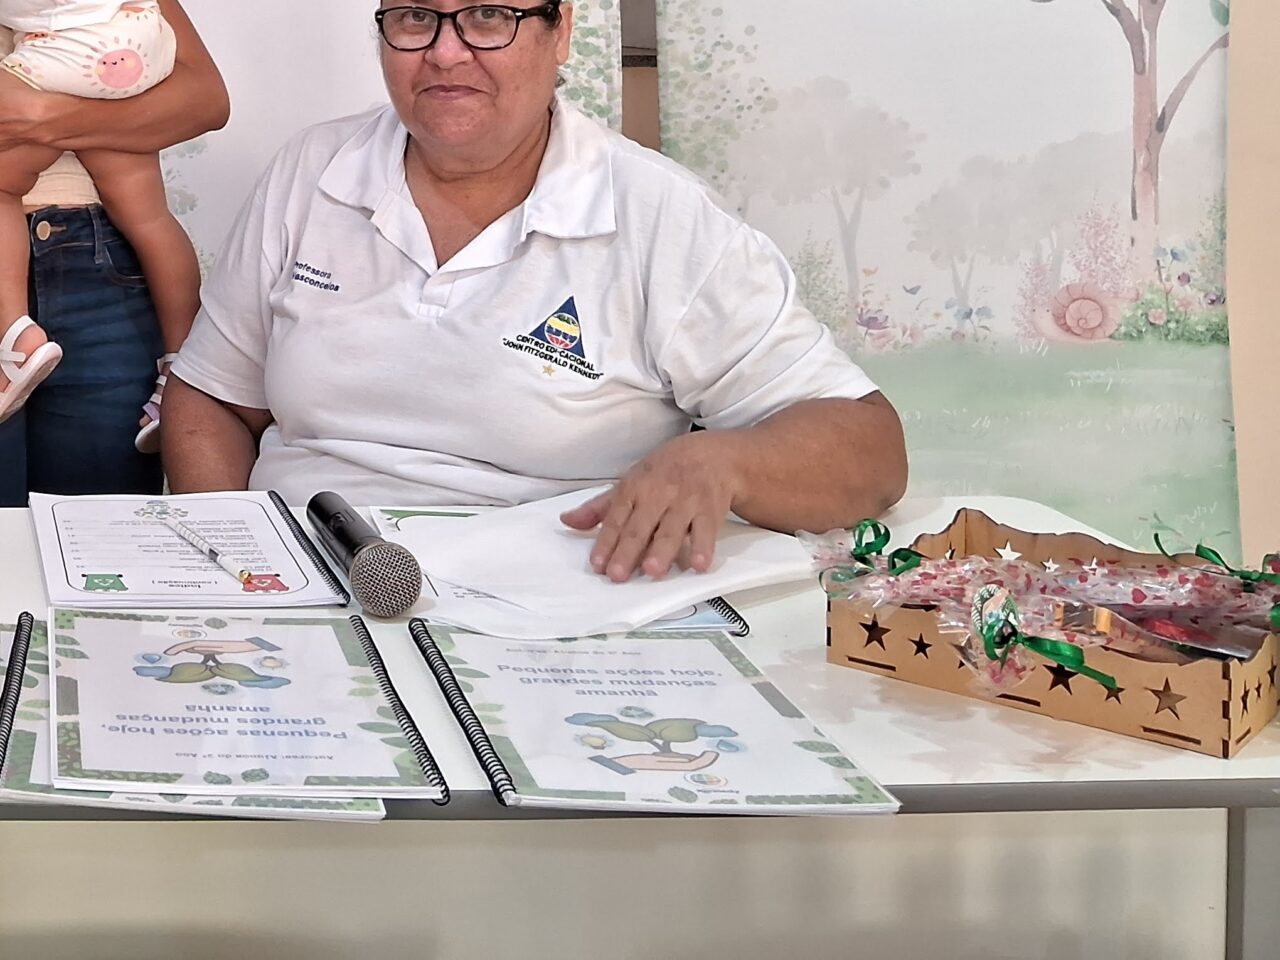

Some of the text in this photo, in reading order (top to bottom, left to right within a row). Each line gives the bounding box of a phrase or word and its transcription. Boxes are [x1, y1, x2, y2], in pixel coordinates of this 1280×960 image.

[497, 664, 599, 675] Pequenas
[605, 667, 666, 677] ações
[519, 677, 718, 688] grandes mudanças
[115, 714, 326, 727] grandes mudanças
[163, 727, 228, 737] ações
[236, 729, 348, 740] Pequenas
